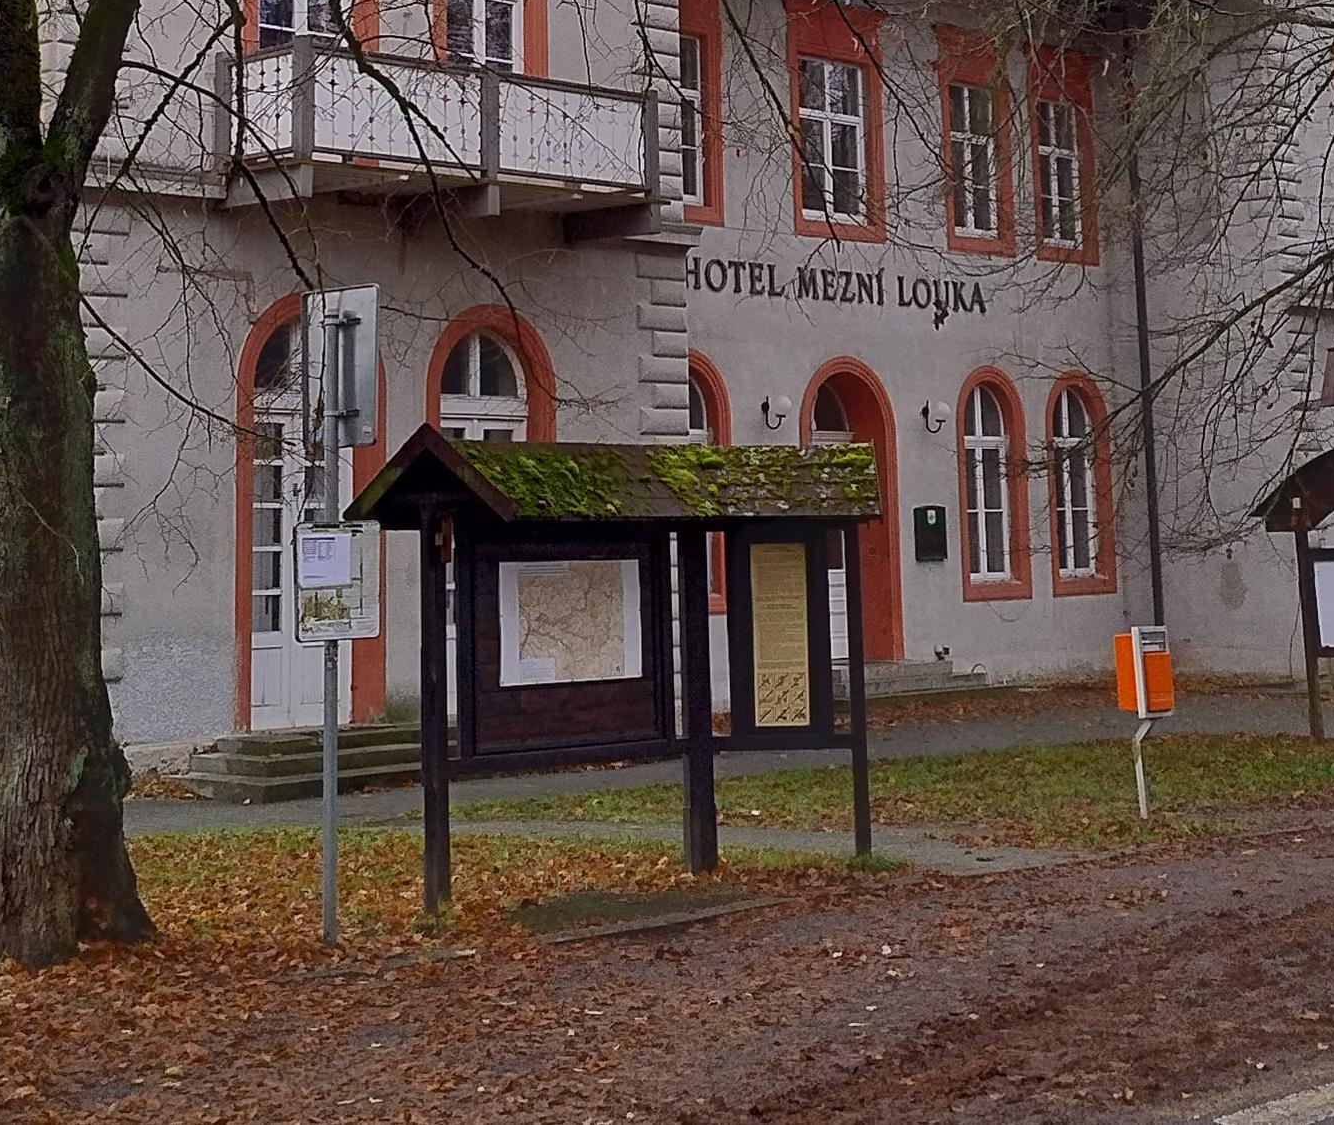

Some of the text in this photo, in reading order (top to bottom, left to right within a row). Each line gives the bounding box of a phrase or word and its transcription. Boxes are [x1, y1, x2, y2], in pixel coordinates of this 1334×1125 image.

[685, 256, 987, 314] HOTEL MEZNÍ LOUKA
